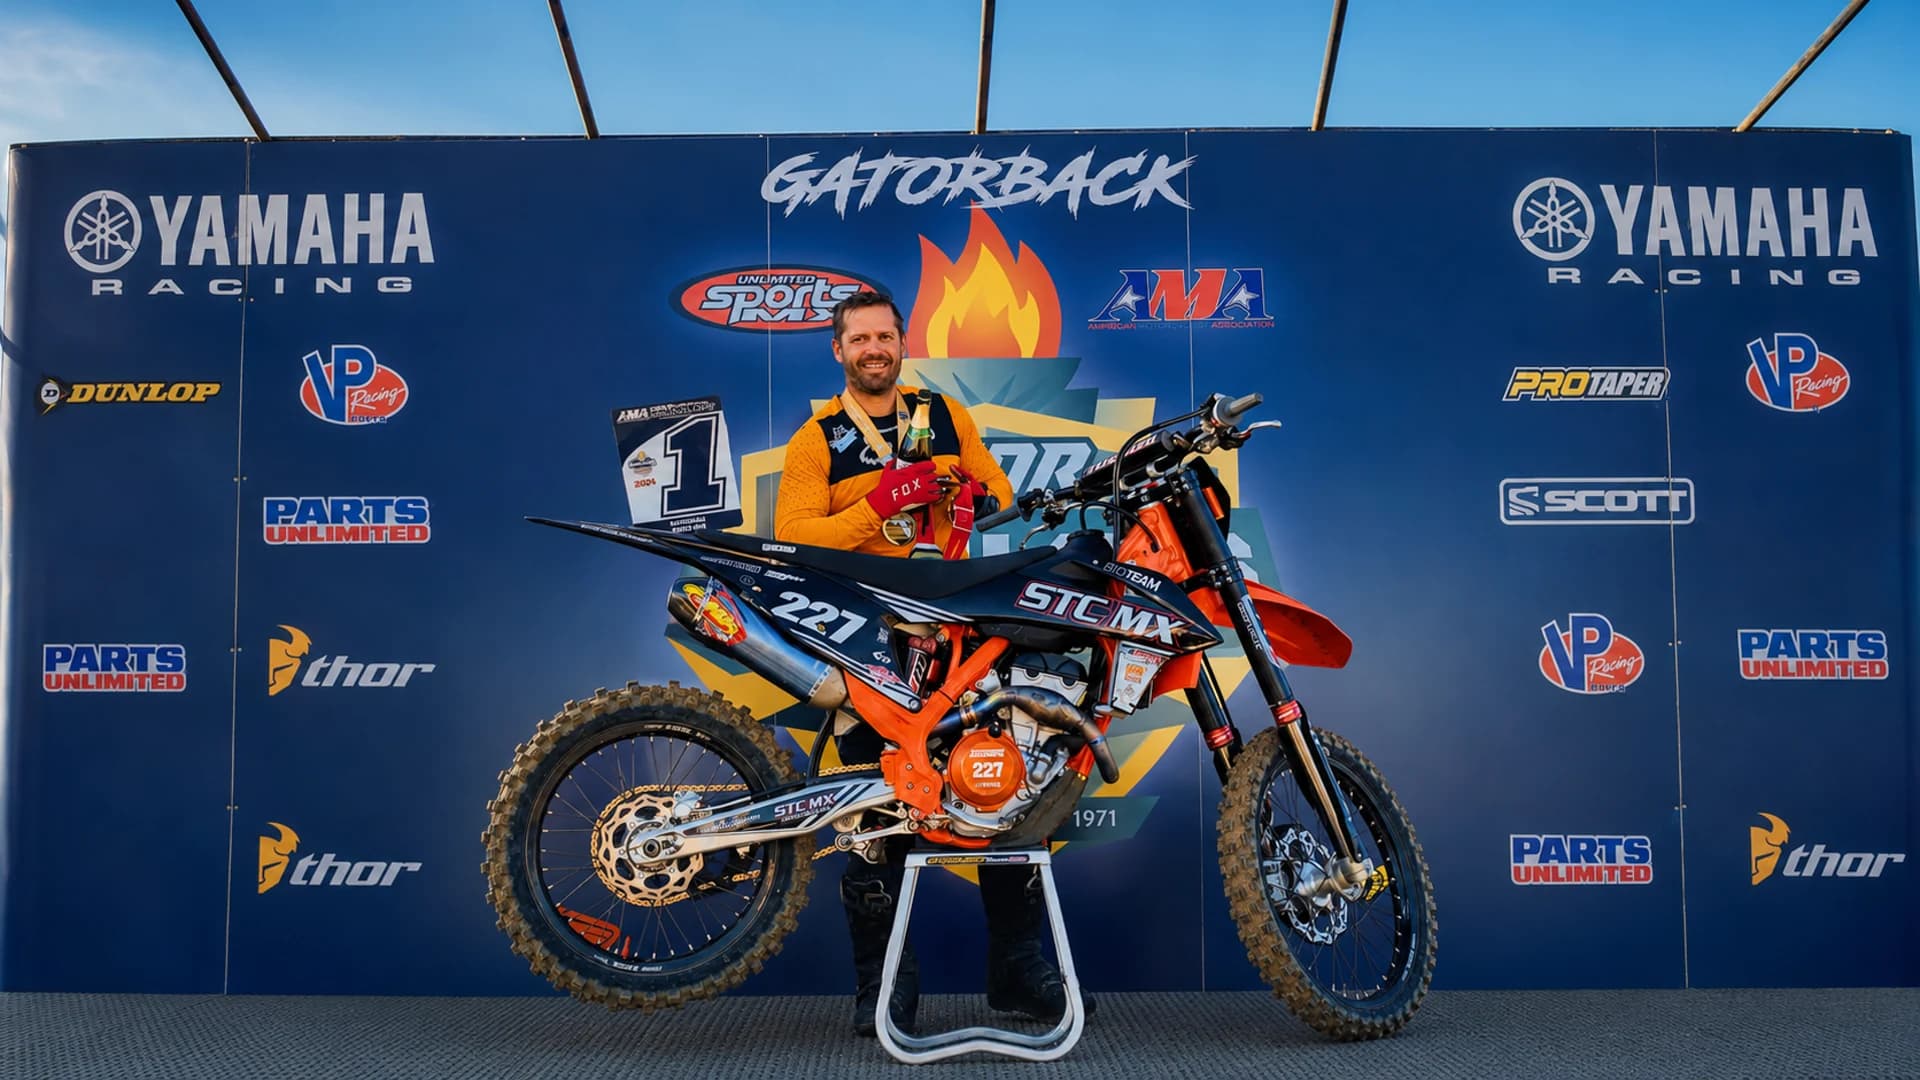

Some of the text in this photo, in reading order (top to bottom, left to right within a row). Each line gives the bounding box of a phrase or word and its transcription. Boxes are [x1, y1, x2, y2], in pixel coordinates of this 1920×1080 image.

[760, 148, 1197, 220] GATORBACK
[149, 193, 435, 266] YAMAHA
[1600, 185, 1878, 257] YAMAHA
[92, 278, 413, 296] RACING
[738, 275, 816, 285] UNLIMITED
[1548, 267, 1861, 285] RACING
[1088, 268, 1274, 321] AMA
[302, 344, 377, 424] VP
[1746, 333, 1819, 410] VP
[66, 383, 221, 403] DUNLOP
[351, 387, 405, 413] Racing
[1795, 375, 1848, 400] Racing
[661, 411, 727, 518] 1
[891, 477, 921, 501] FOX
[1544, 489, 1688, 512] SCOTT
[264, 496, 430, 526] PARTS
[265, 525, 430, 543] UNLIMITED
[770, 591, 868, 645] 227
[1018, 582, 1104, 627] STC
[1109, 604, 1189, 646] MX
[44, 644, 185, 673] PARTS
[1541, 613, 1614, 693] VP
[1738, 630, 1887, 660] PARTS
[44, 672, 186, 692] UNLIMITED
[301, 655, 436, 687] thor
[1590, 656, 1642, 682] Racing
[1741, 659, 1888, 680] UNLIMITED
[972, 761, 1004, 778] 227
[774, 802, 805, 818] STC
[809, 793, 835, 811] MX
[1074, 809, 1117, 828] 1971
[1511, 834, 1650, 864] PARTS
[1782, 843, 1906, 878] thor
[289, 853, 422, 886] thor
[1512, 863, 1652, 884] UNLIMITED
